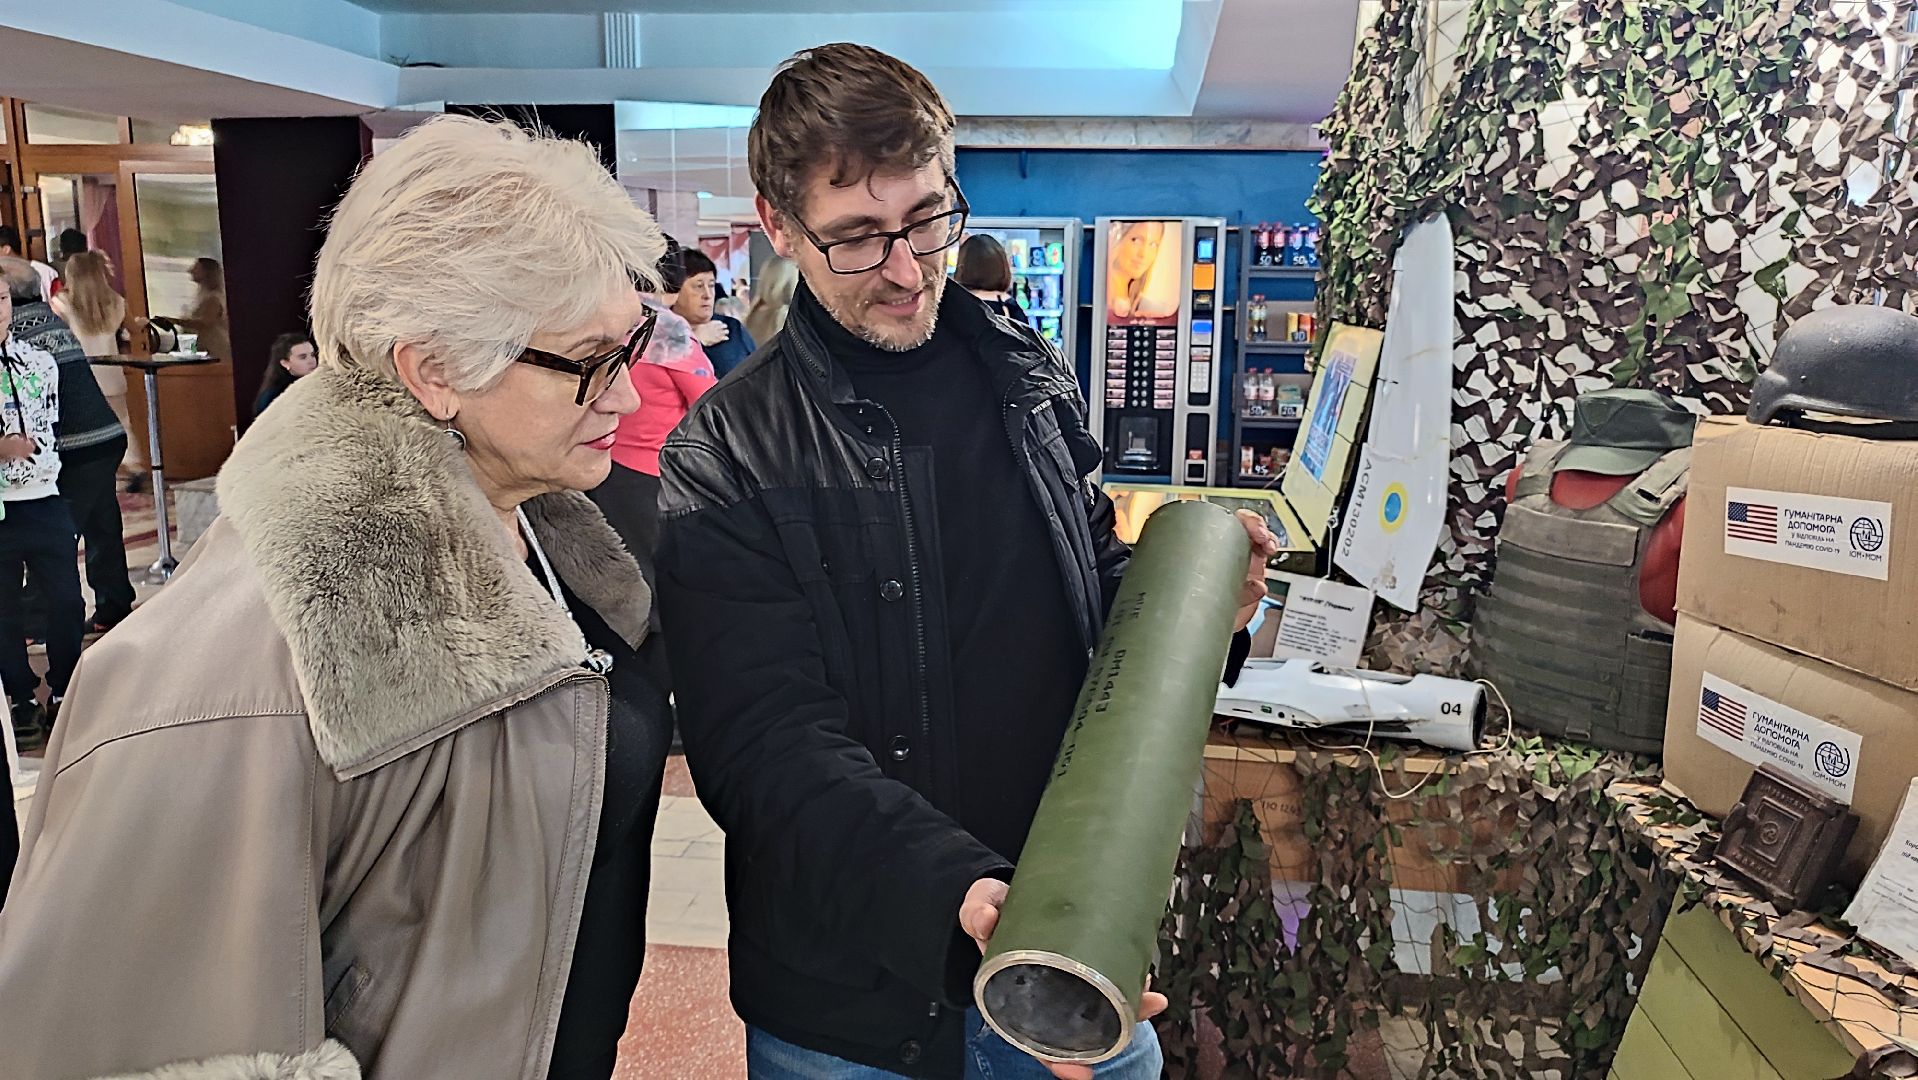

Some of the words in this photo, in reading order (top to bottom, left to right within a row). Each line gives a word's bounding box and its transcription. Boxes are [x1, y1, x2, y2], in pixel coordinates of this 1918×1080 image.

[1341, 458, 1372, 557] ACM130202
[1784, 508, 1843, 525] ГУМАНІТАРНА
[1787, 520, 1836, 535] ДОПОМОГА
[1440, 701, 1462, 716] 04
[1752, 711, 1810, 743] ГУМАНІТАРНА
[1753, 723, 1801, 750] ДОПОМОГА
